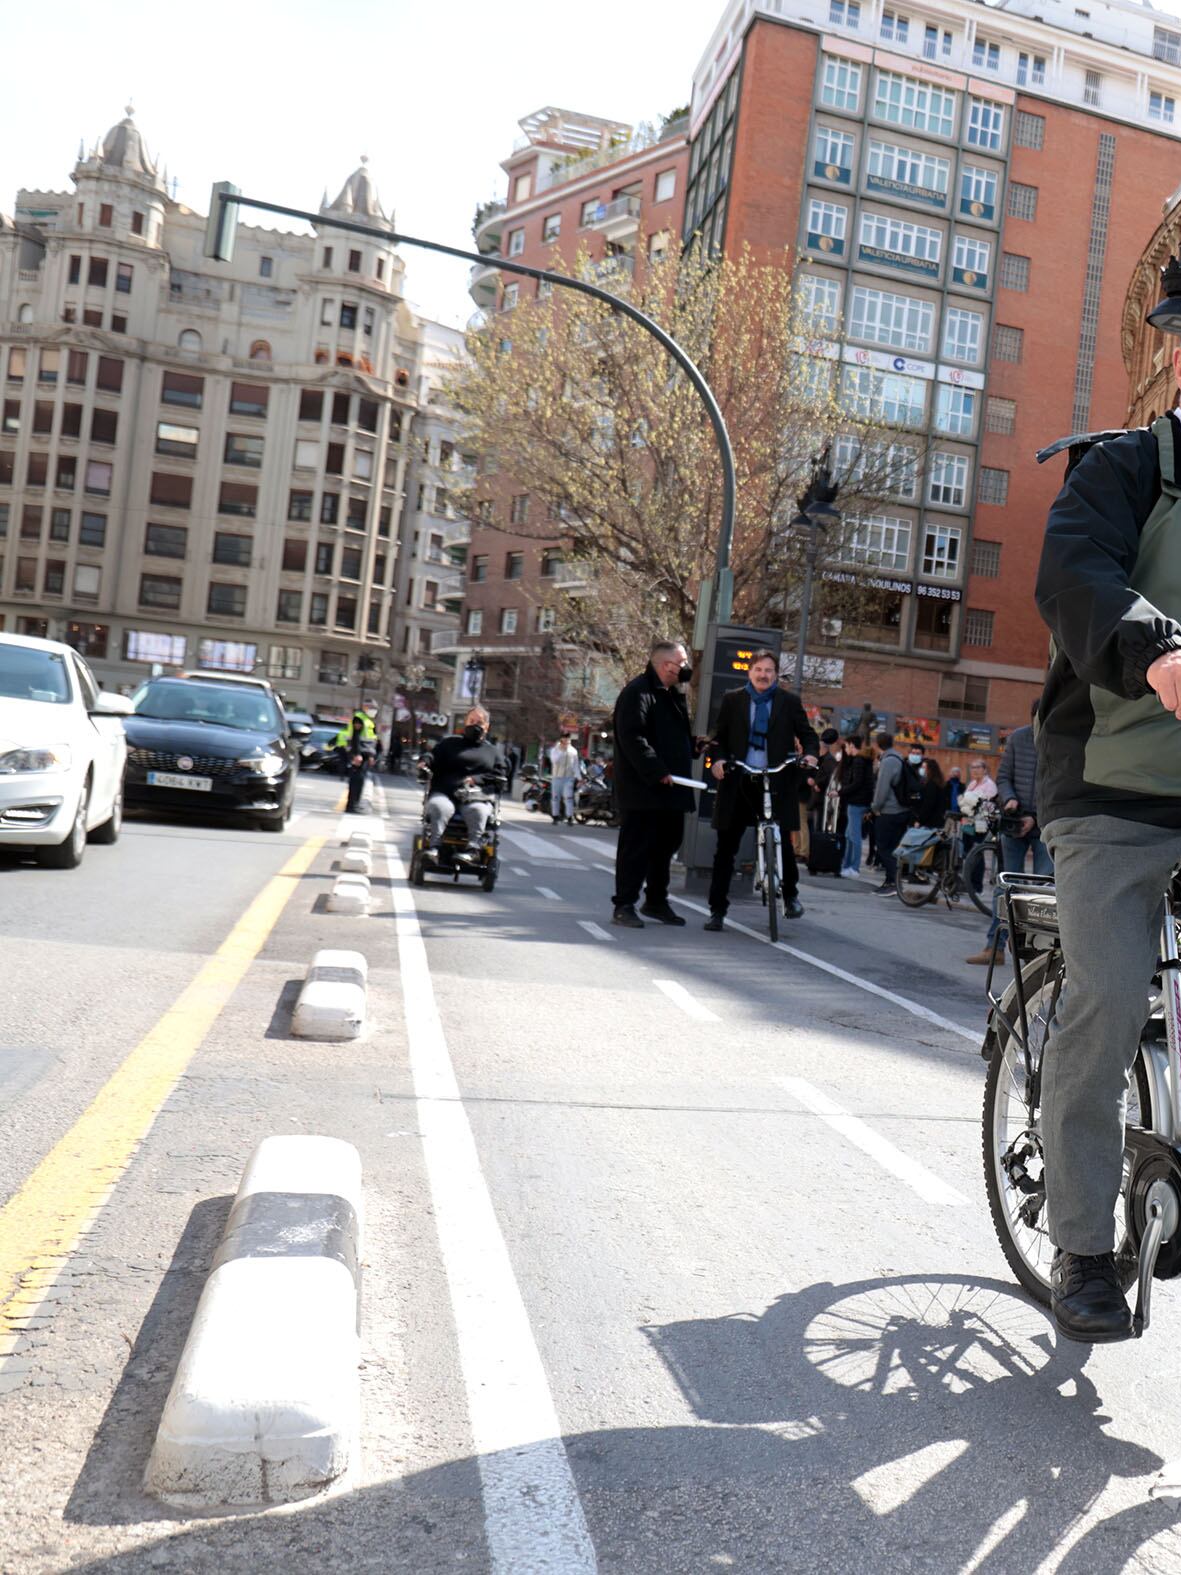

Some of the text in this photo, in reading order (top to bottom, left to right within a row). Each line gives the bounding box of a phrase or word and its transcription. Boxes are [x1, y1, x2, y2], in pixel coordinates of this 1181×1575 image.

[906, 364, 926, 373] COPE
[917, 585, 961, 601] 96 352 53 53
